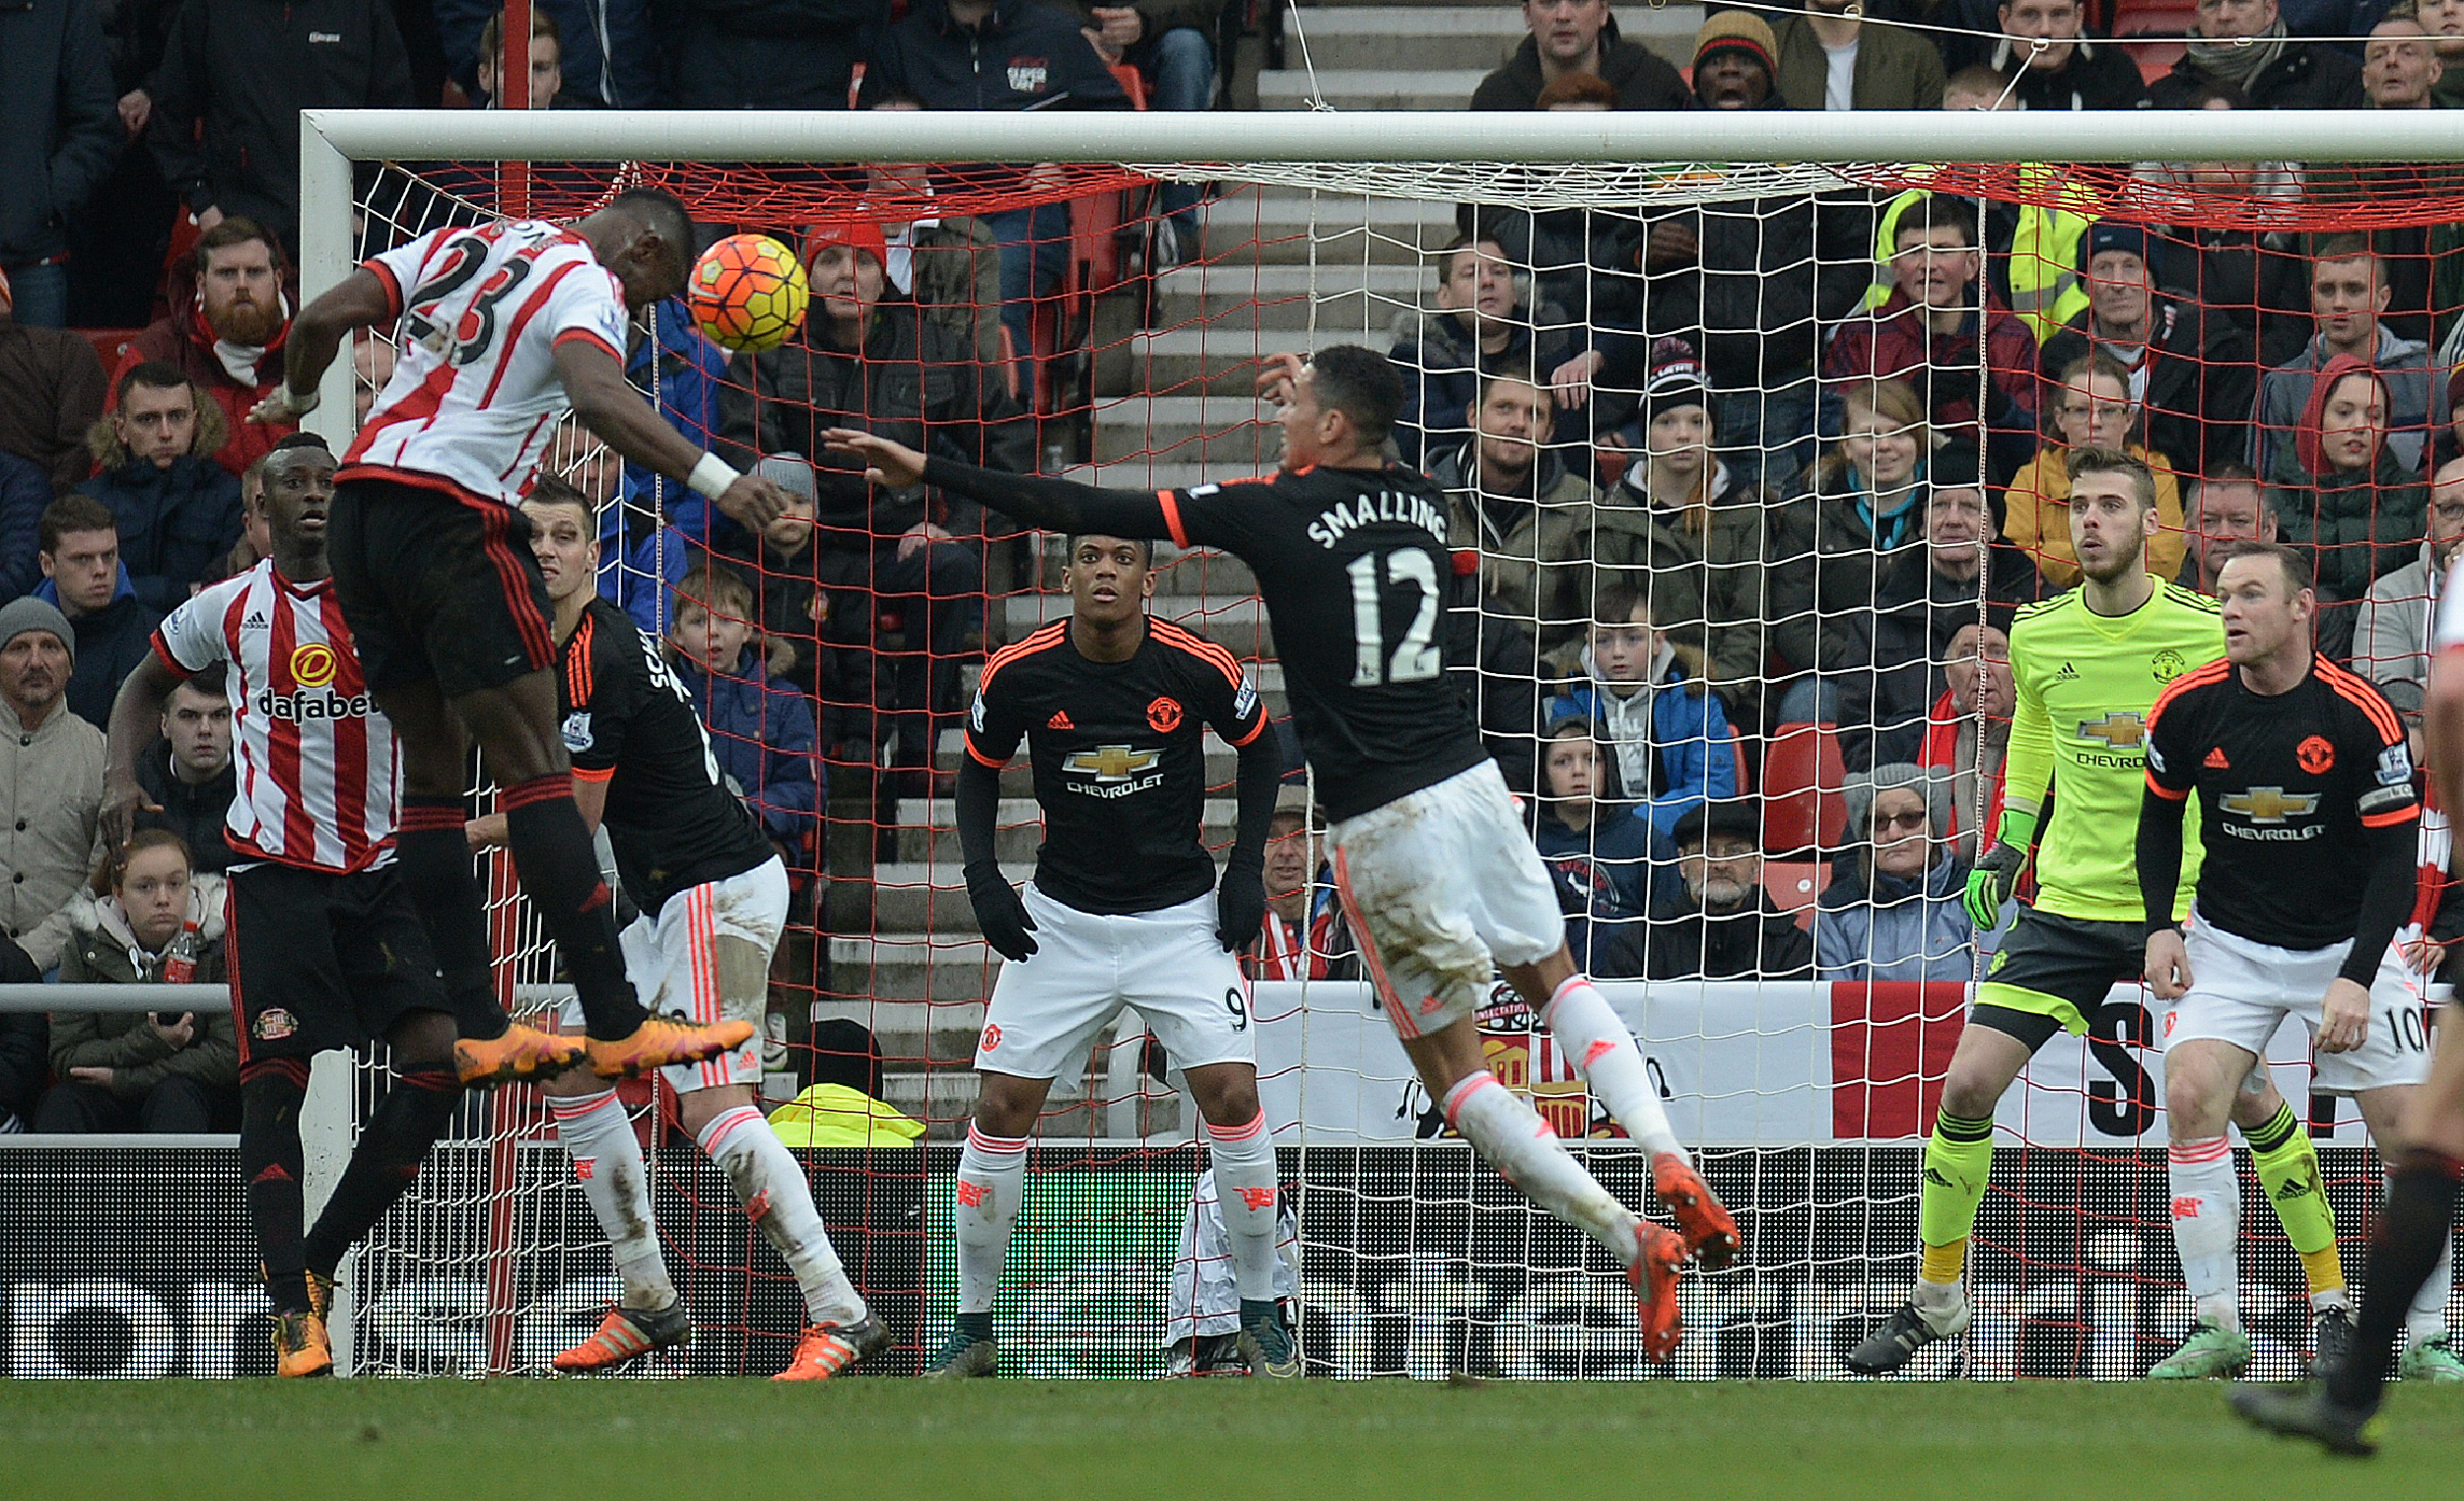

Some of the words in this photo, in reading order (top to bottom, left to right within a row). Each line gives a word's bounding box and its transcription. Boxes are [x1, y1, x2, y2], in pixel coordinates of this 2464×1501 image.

[404, 235, 534, 367] 23
[1307, 490, 1447, 549] SMALLING
[1344, 546, 1442, 688] 12
[2076, 752, 2147, 769] CHEVRO
[1066, 773, 1164, 799] CHEVROLET
[2222, 822, 2327, 842] CHEVROLET
[1225, 987, 1248, 1034] 9
[2383, 1005, 2426, 1055] 10
